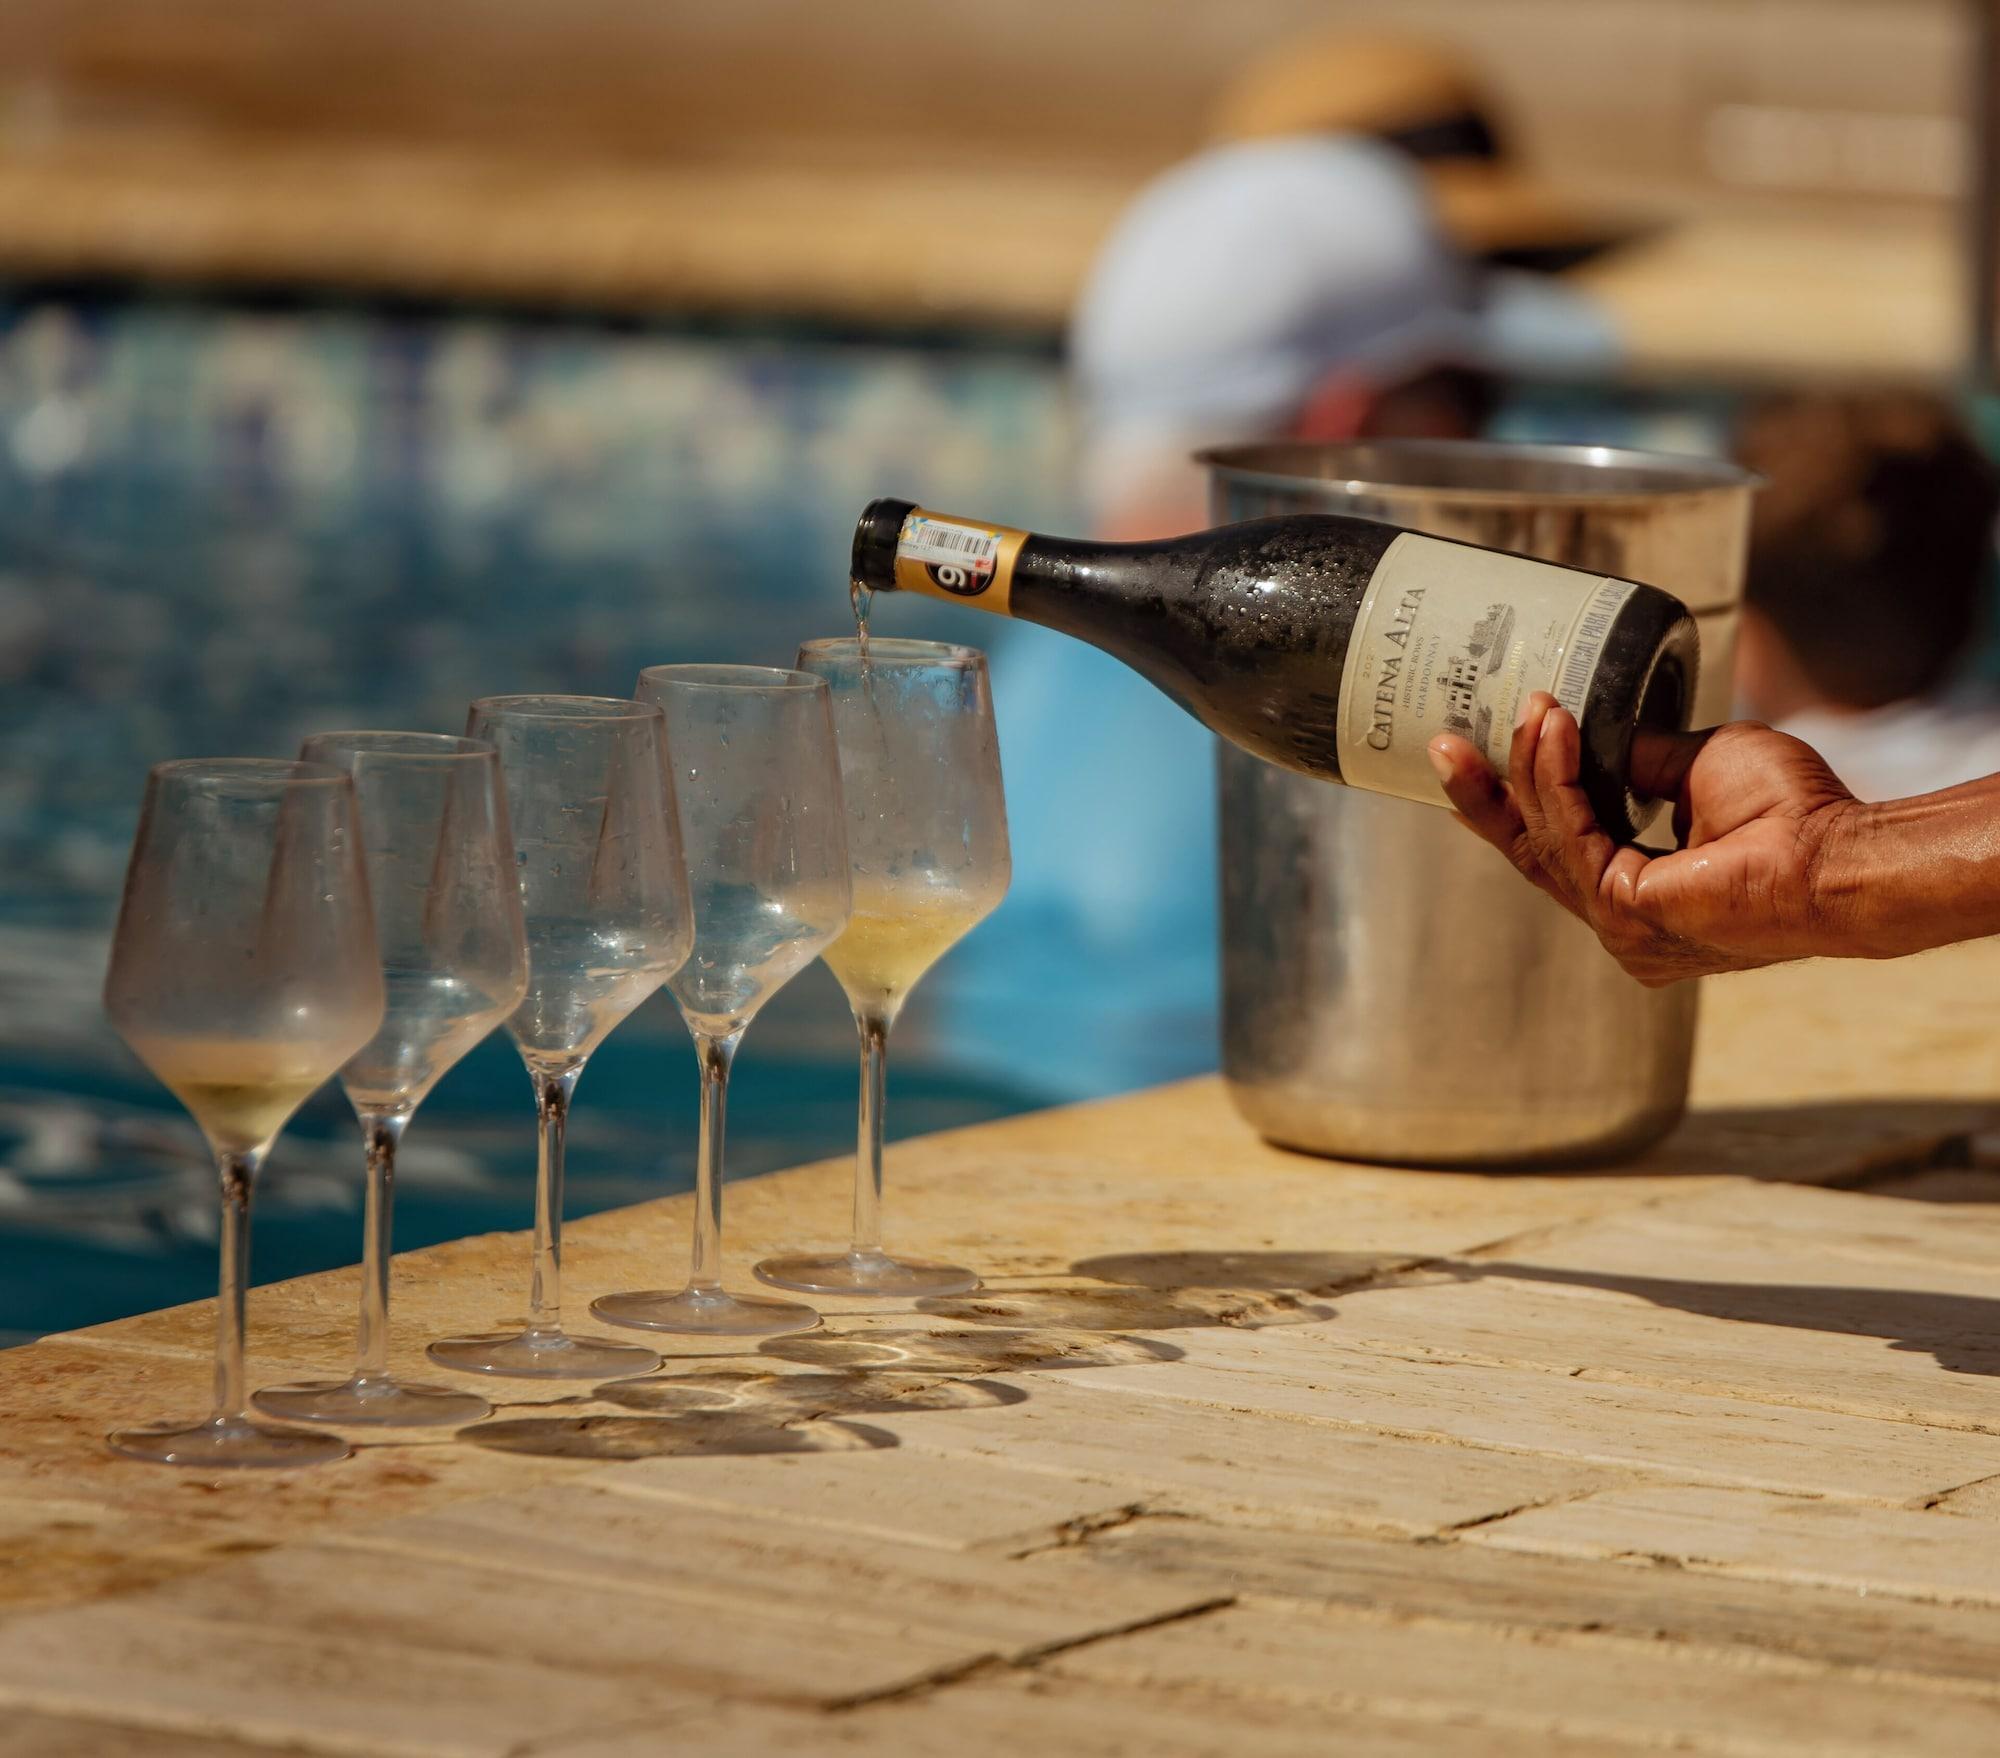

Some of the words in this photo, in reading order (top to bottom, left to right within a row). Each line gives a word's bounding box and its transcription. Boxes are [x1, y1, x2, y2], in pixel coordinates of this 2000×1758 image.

[1384, 588, 1426, 650] ALTA
[1580, 612, 1611, 639] PARA
[1592, 599, 1617, 611] LA
[1366, 656, 1403, 752] CATENA
[1403, 663, 1417, 709] HISTORIC
[1411, 636, 1425, 663] ROWS
[1416, 632, 1441, 718] CHARDONNAY
